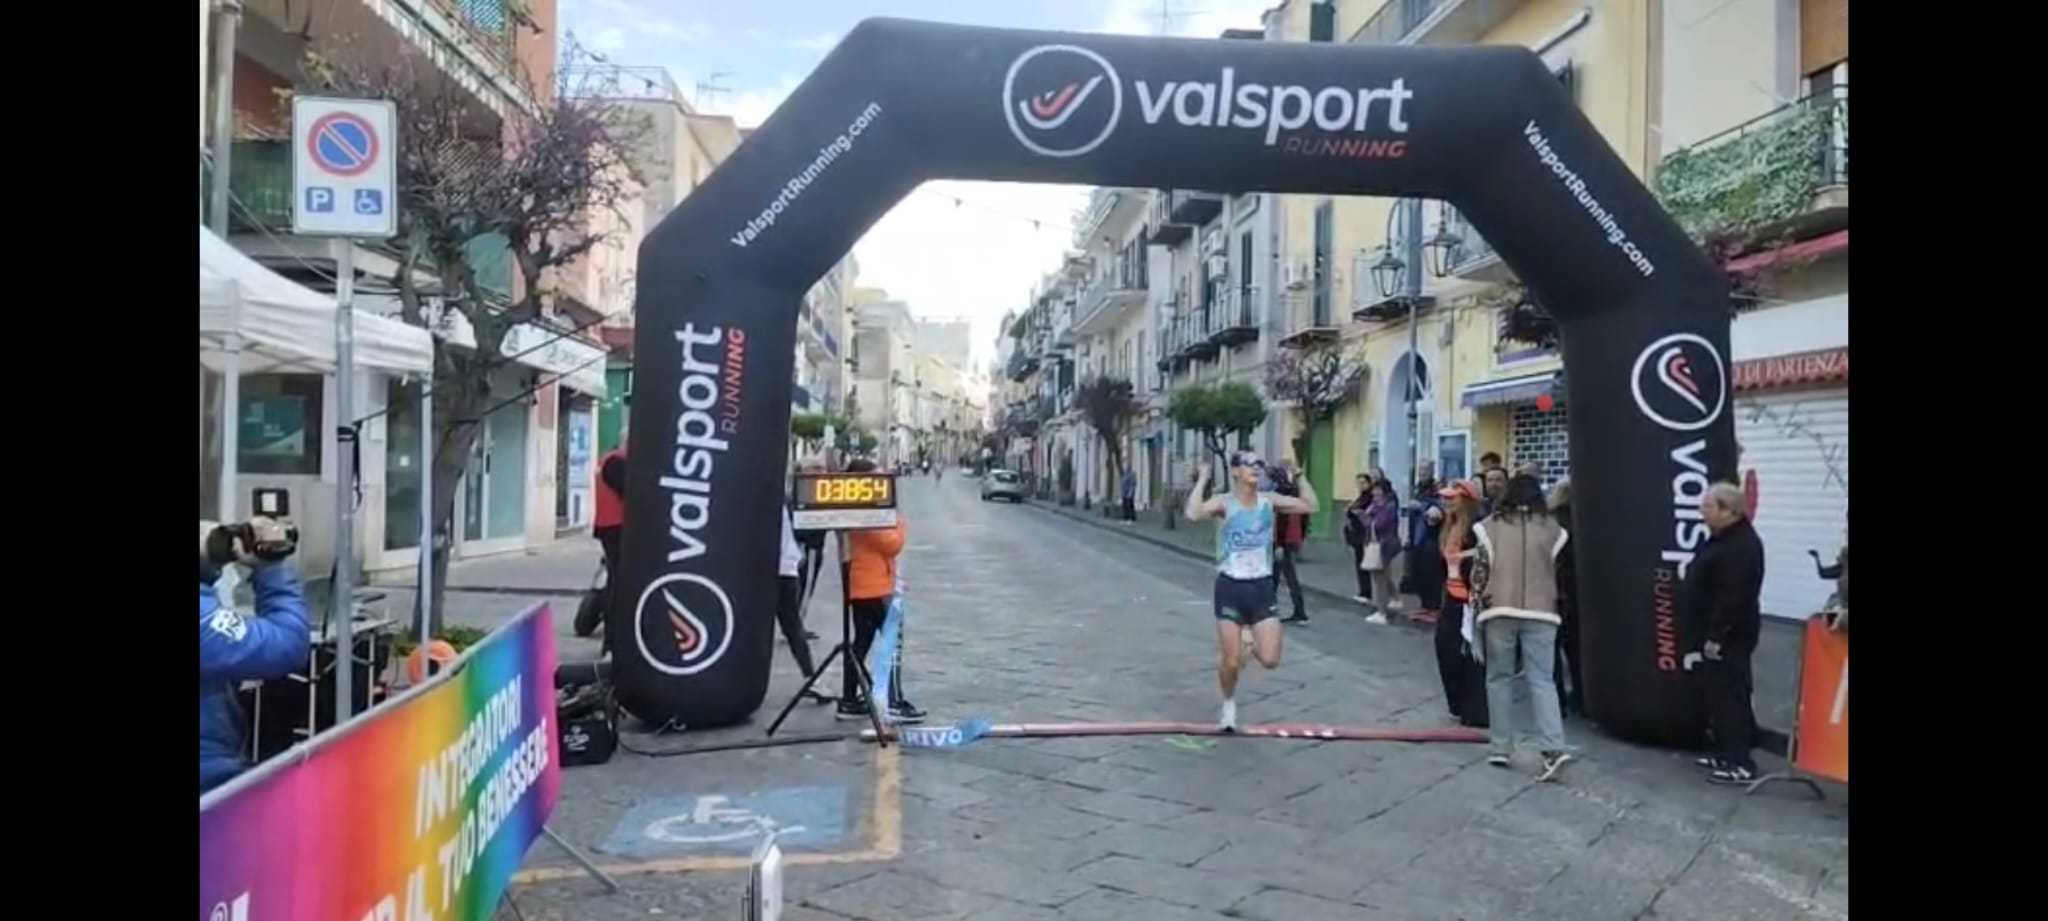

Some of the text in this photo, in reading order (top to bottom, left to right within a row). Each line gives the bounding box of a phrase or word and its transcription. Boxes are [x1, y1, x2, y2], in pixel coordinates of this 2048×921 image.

[1135, 67, 1413, 145] valsport
[1283, 137, 1407, 158] RUNNING
[311, 190, 330, 211] P
[730, 101, 882, 248] ValsportRunning.com
[1524, 119, 1655, 277] ValsportRunning.com
[721, 327, 745, 435] RUNNING
[658, 322, 730, 563] valsport
[816, 477, 888, 503] 03854
[1653, 567, 1677, 671] RUNNING
[416, 673, 522, 839] INTEGRATORI
[438, 809, 476, 912] TUO
